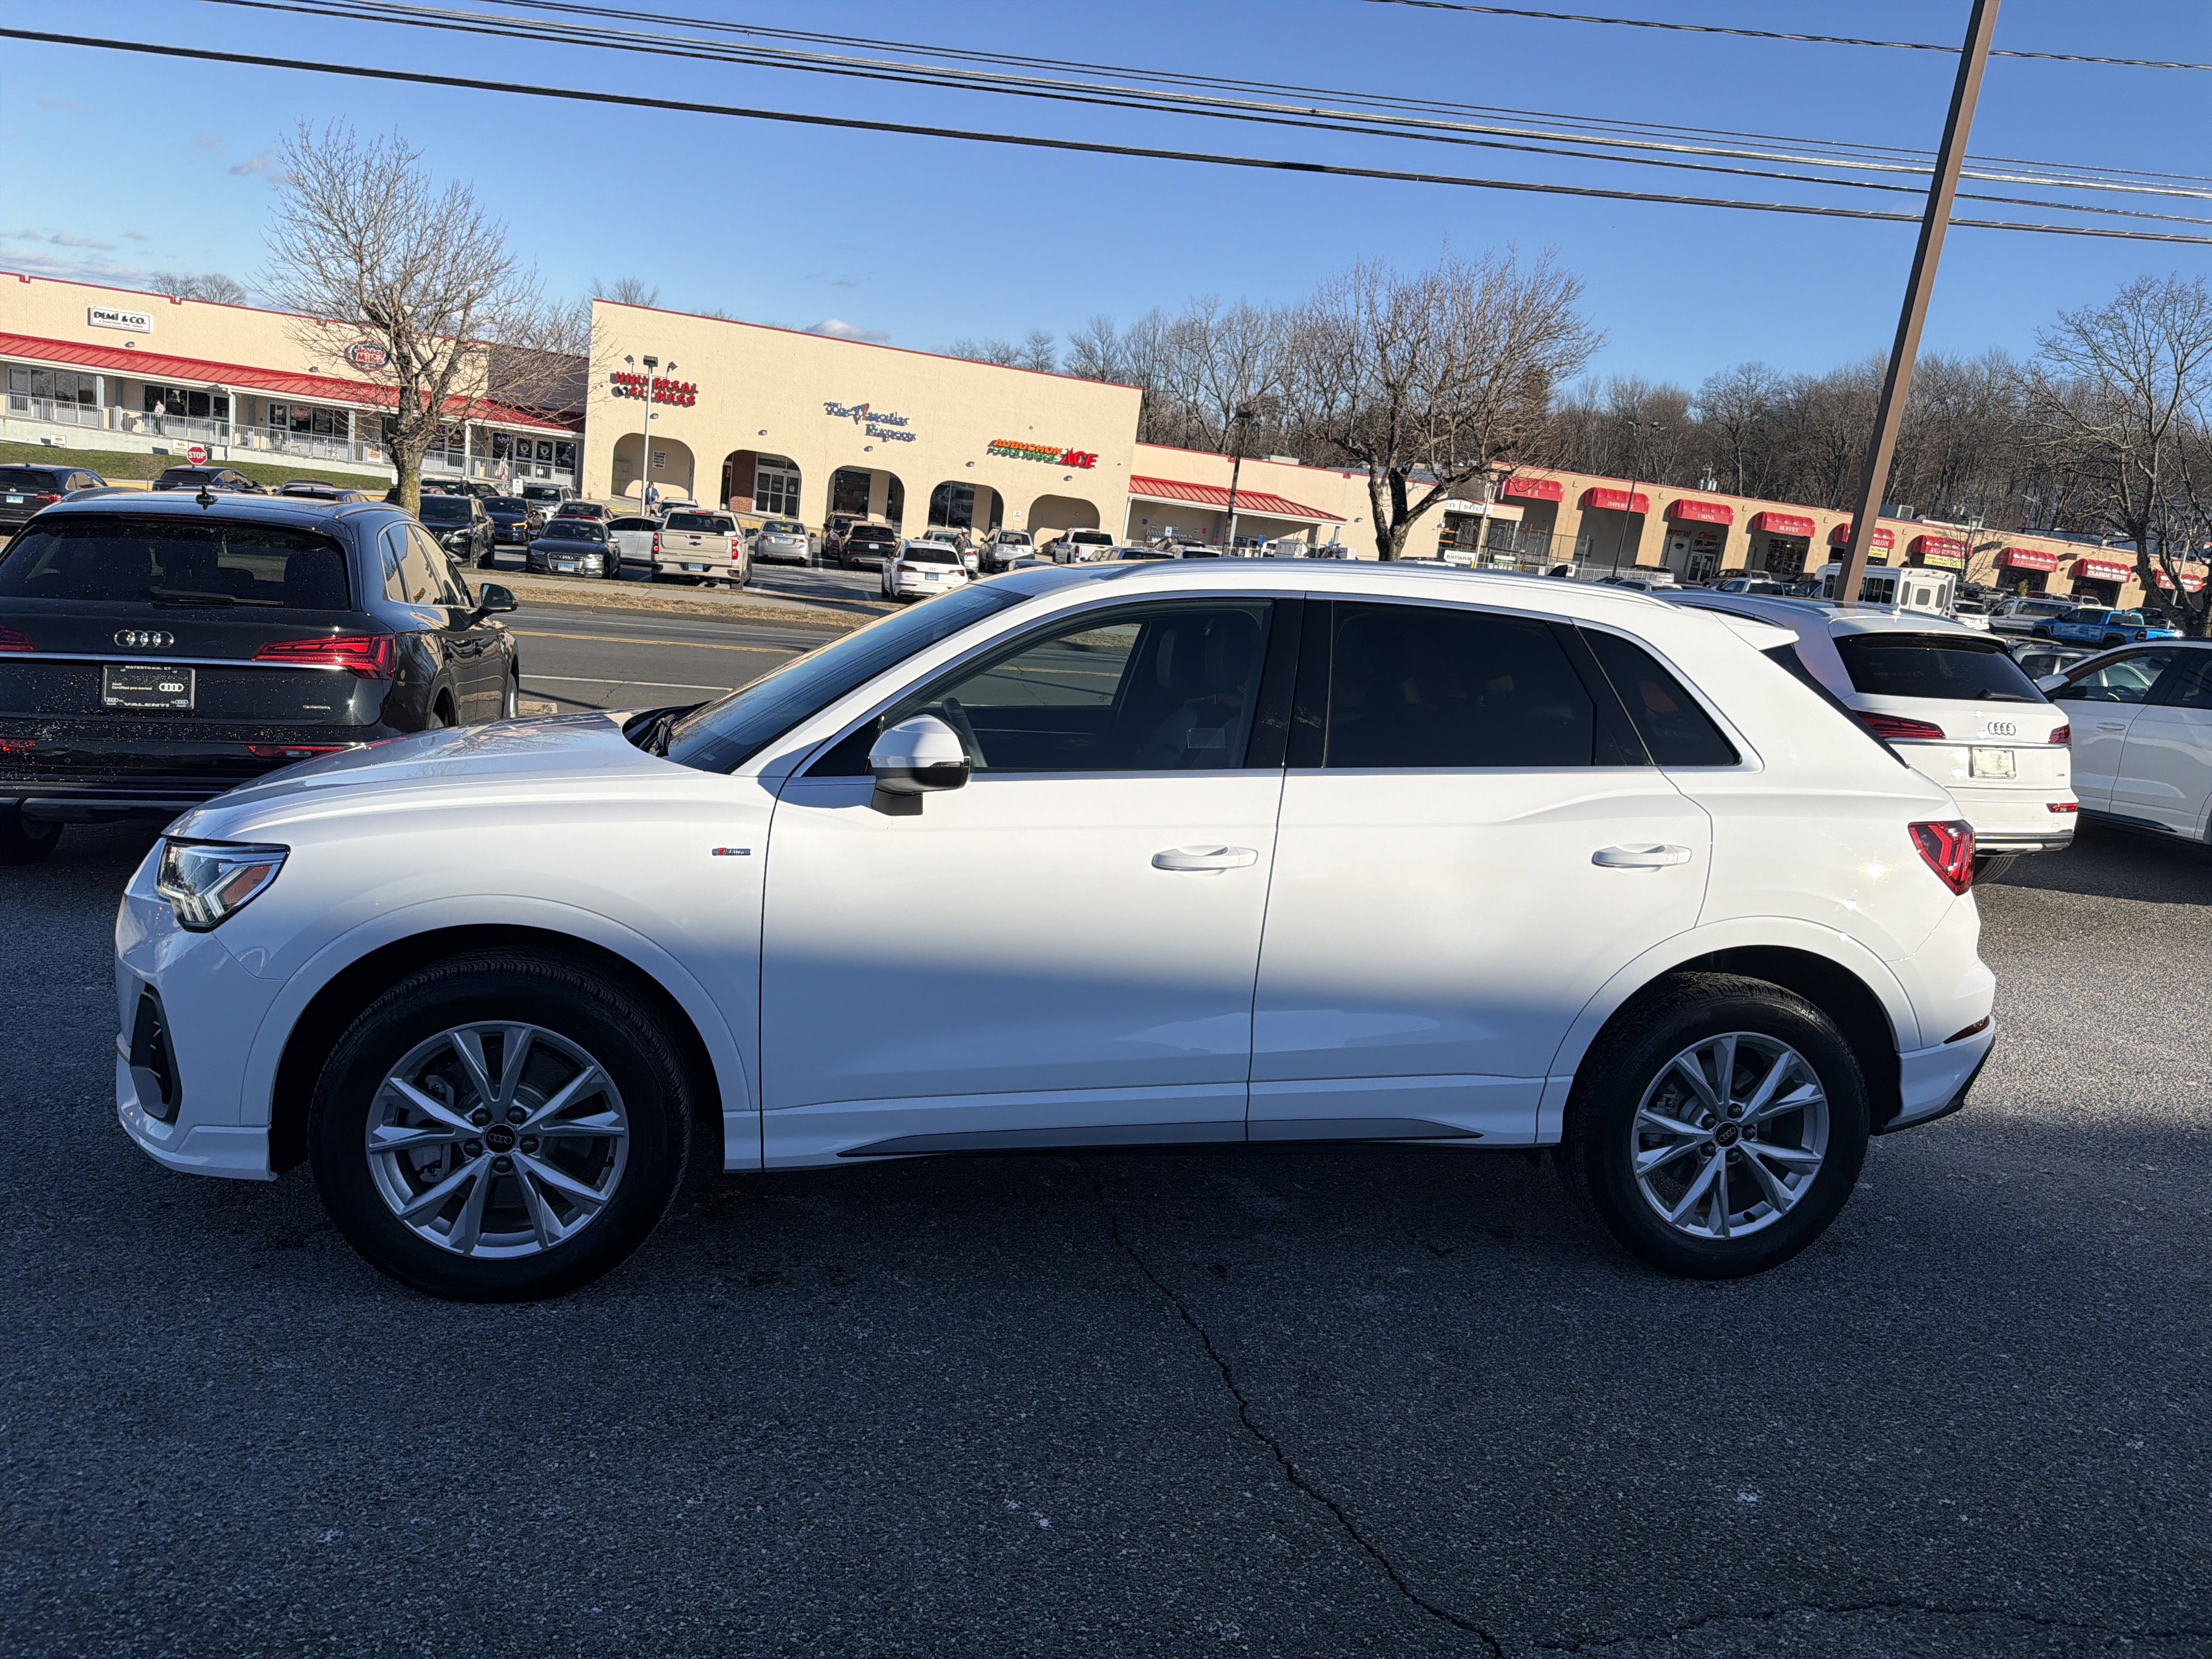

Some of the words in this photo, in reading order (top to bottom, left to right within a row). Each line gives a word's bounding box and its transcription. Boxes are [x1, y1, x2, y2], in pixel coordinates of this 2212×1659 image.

[93, 311, 119, 320] DEMI
[631, 386, 696, 407] FINESS
[823, 402, 855, 417] The
[852, 403, 910, 426] Vascular
[865, 424, 917, 442] Experts
[993, 439, 1063, 455] AUBUCHON
[990, 447, 1062, 464] HARDWARE
[1060, 448, 1099, 468] ACE
[1872, 539, 1889, 547] SALON
